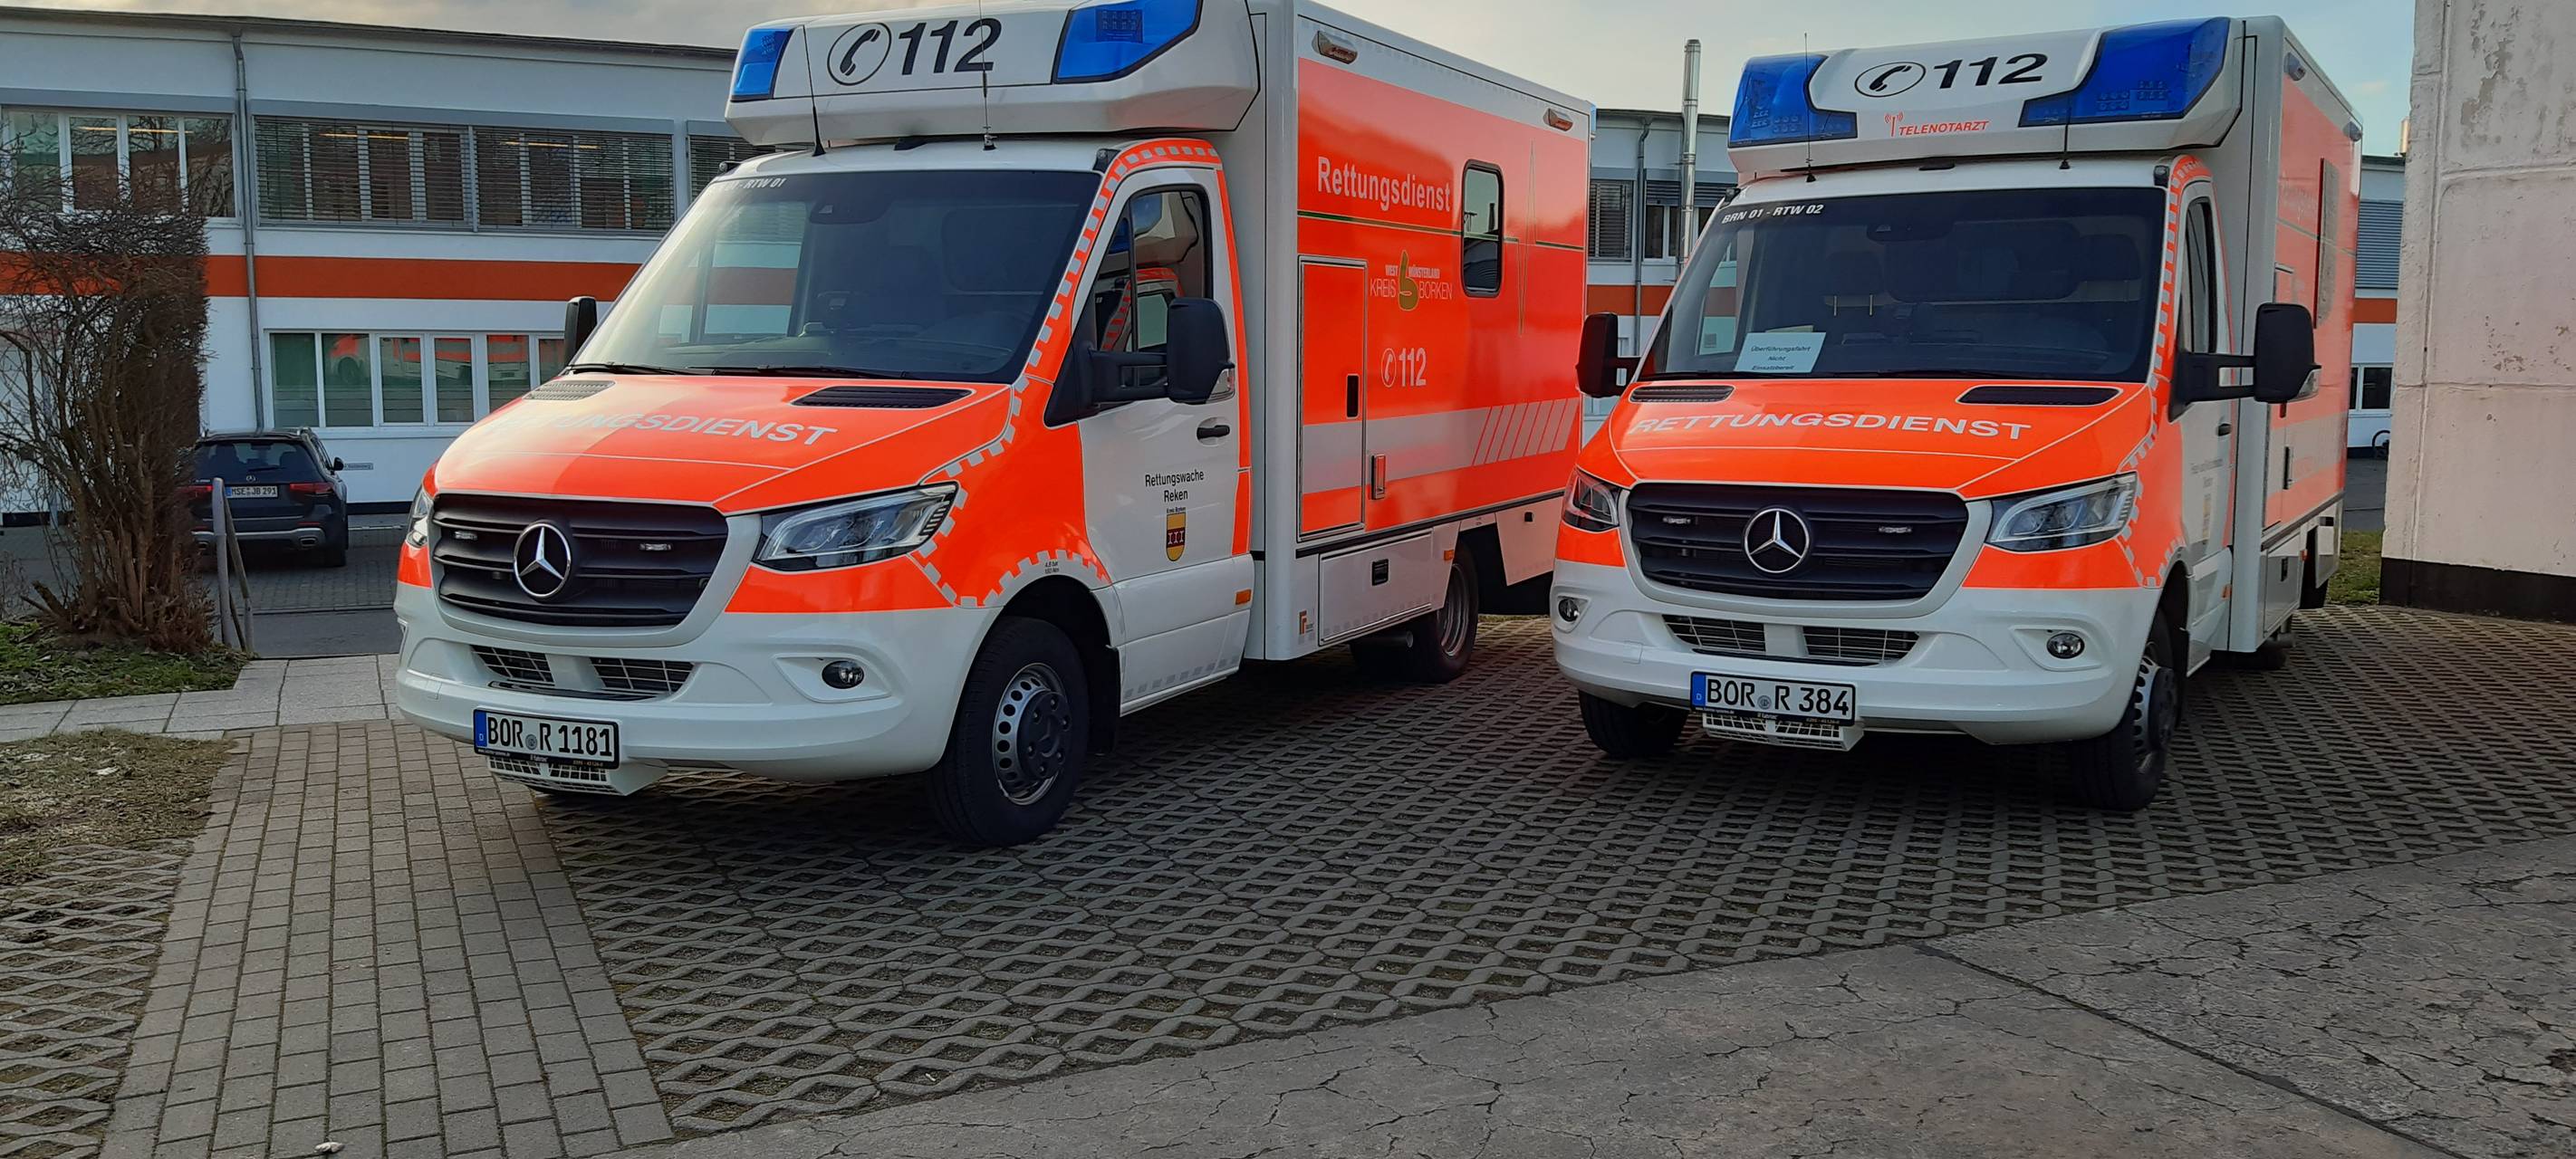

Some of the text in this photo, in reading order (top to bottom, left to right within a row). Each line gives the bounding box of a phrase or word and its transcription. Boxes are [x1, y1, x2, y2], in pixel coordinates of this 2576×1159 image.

[898, 17, 1002, 76] 112
[1933, 53, 2048, 90] 112
[1898, 120, 1990, 137] TELENOTARZT
[743, 178, 772, 188] RTW
[770, 177, 787, 187] 01
[1318, 156, 1452, 212] Rettungsdienst
[1722, 210, 1747, 225] BRN
[1748, 208, 1764, 219] 01
[1773, 205, 1804, 217] RTW
[1806, 204, 1824, 216] 02
[1370, 278, 1453, 301] KREIS BORKEN
[1399, 347, 1427, 388] 112
[485, 412, 838, 446] UNGSDIENST
[1628, 413, 2032, 440] RETTUNGSDIENST
[1145, 469, 1205, 487] Rettungswache
[1163, 488, 1188, 503] Reken
[1696, 693, 1702, 701] D
[1707, 679, 1850, 716] BOR R 384
[487, 716, 612, 757] BOR R 1181
